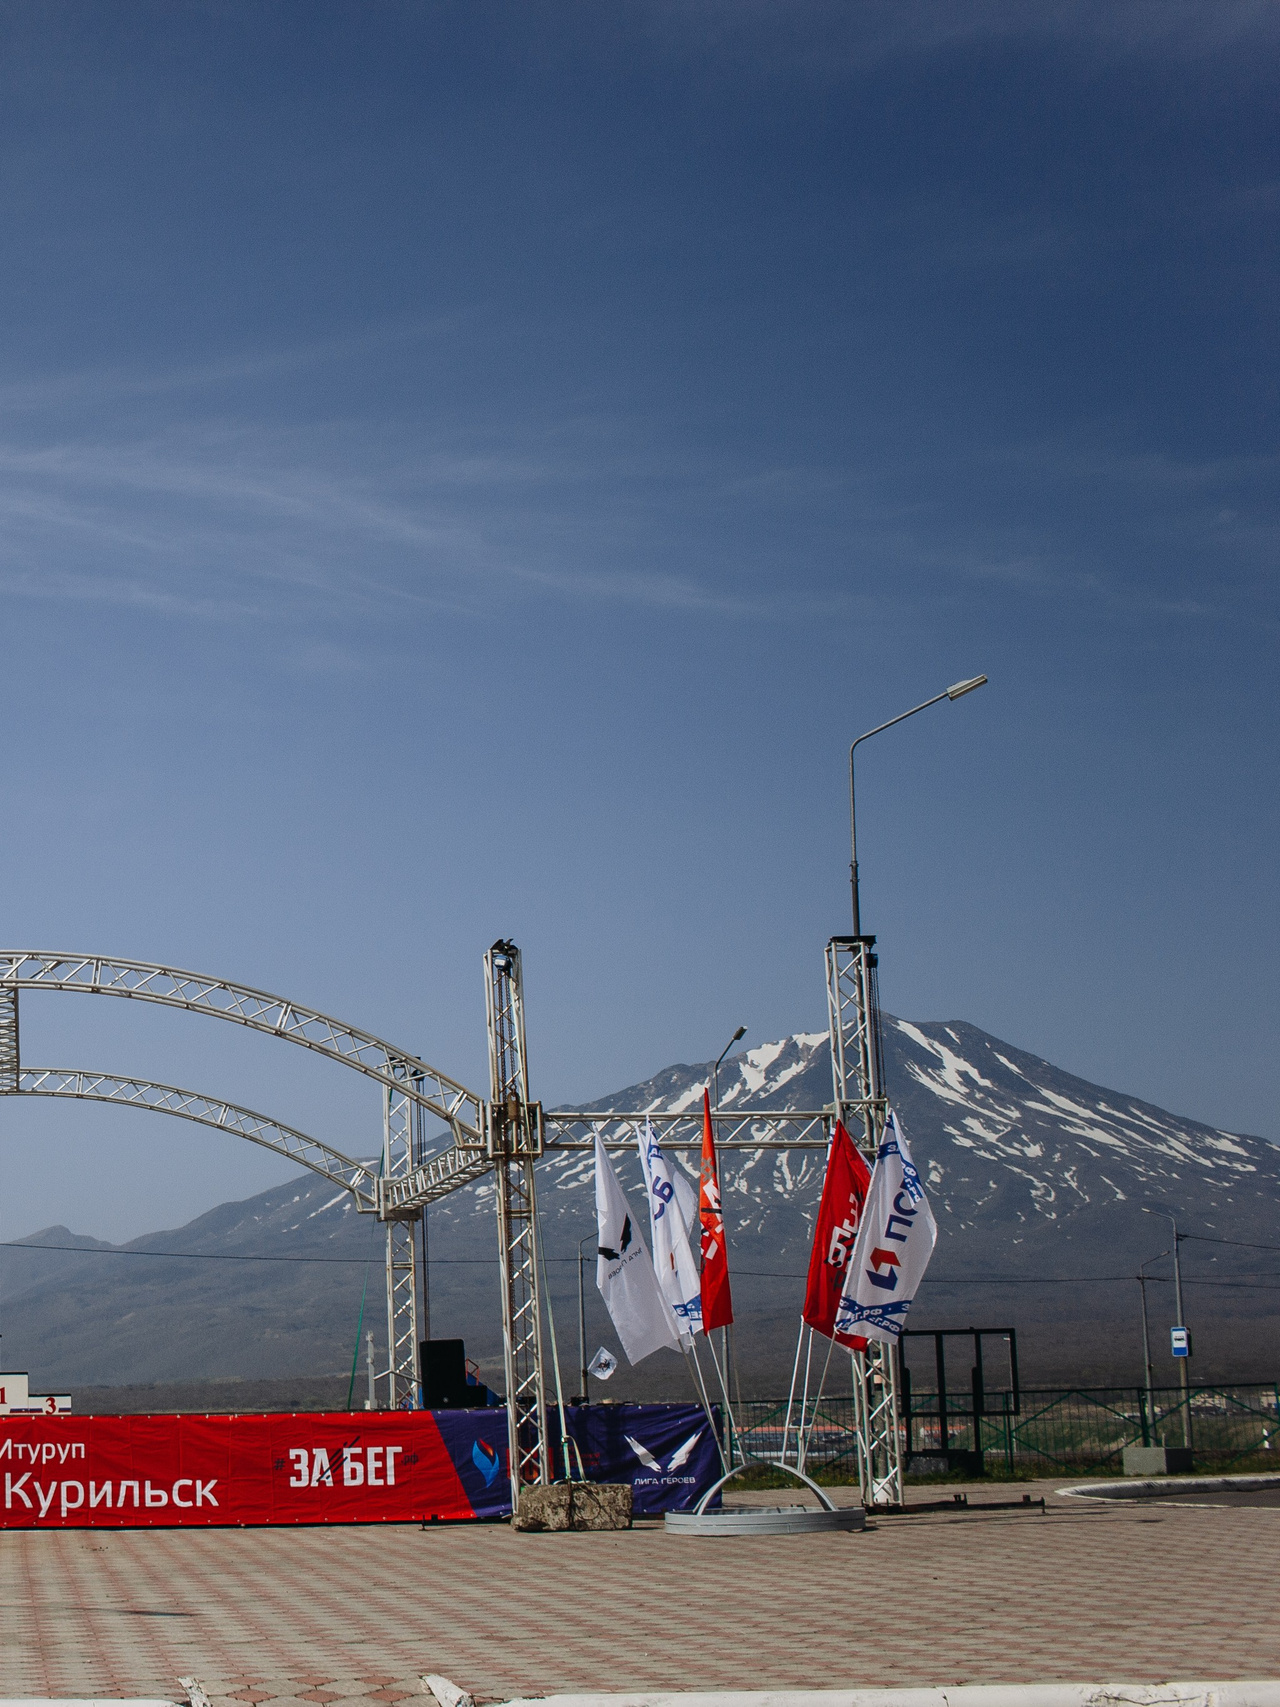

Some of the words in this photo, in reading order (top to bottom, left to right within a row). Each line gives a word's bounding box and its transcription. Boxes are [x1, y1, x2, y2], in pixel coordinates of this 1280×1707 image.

[45, 1397, 56, 1415] 3
[661, 1476, 696, 1485] ГЕРОЕВ
[5, 1472, 219, 1517] Курильск
